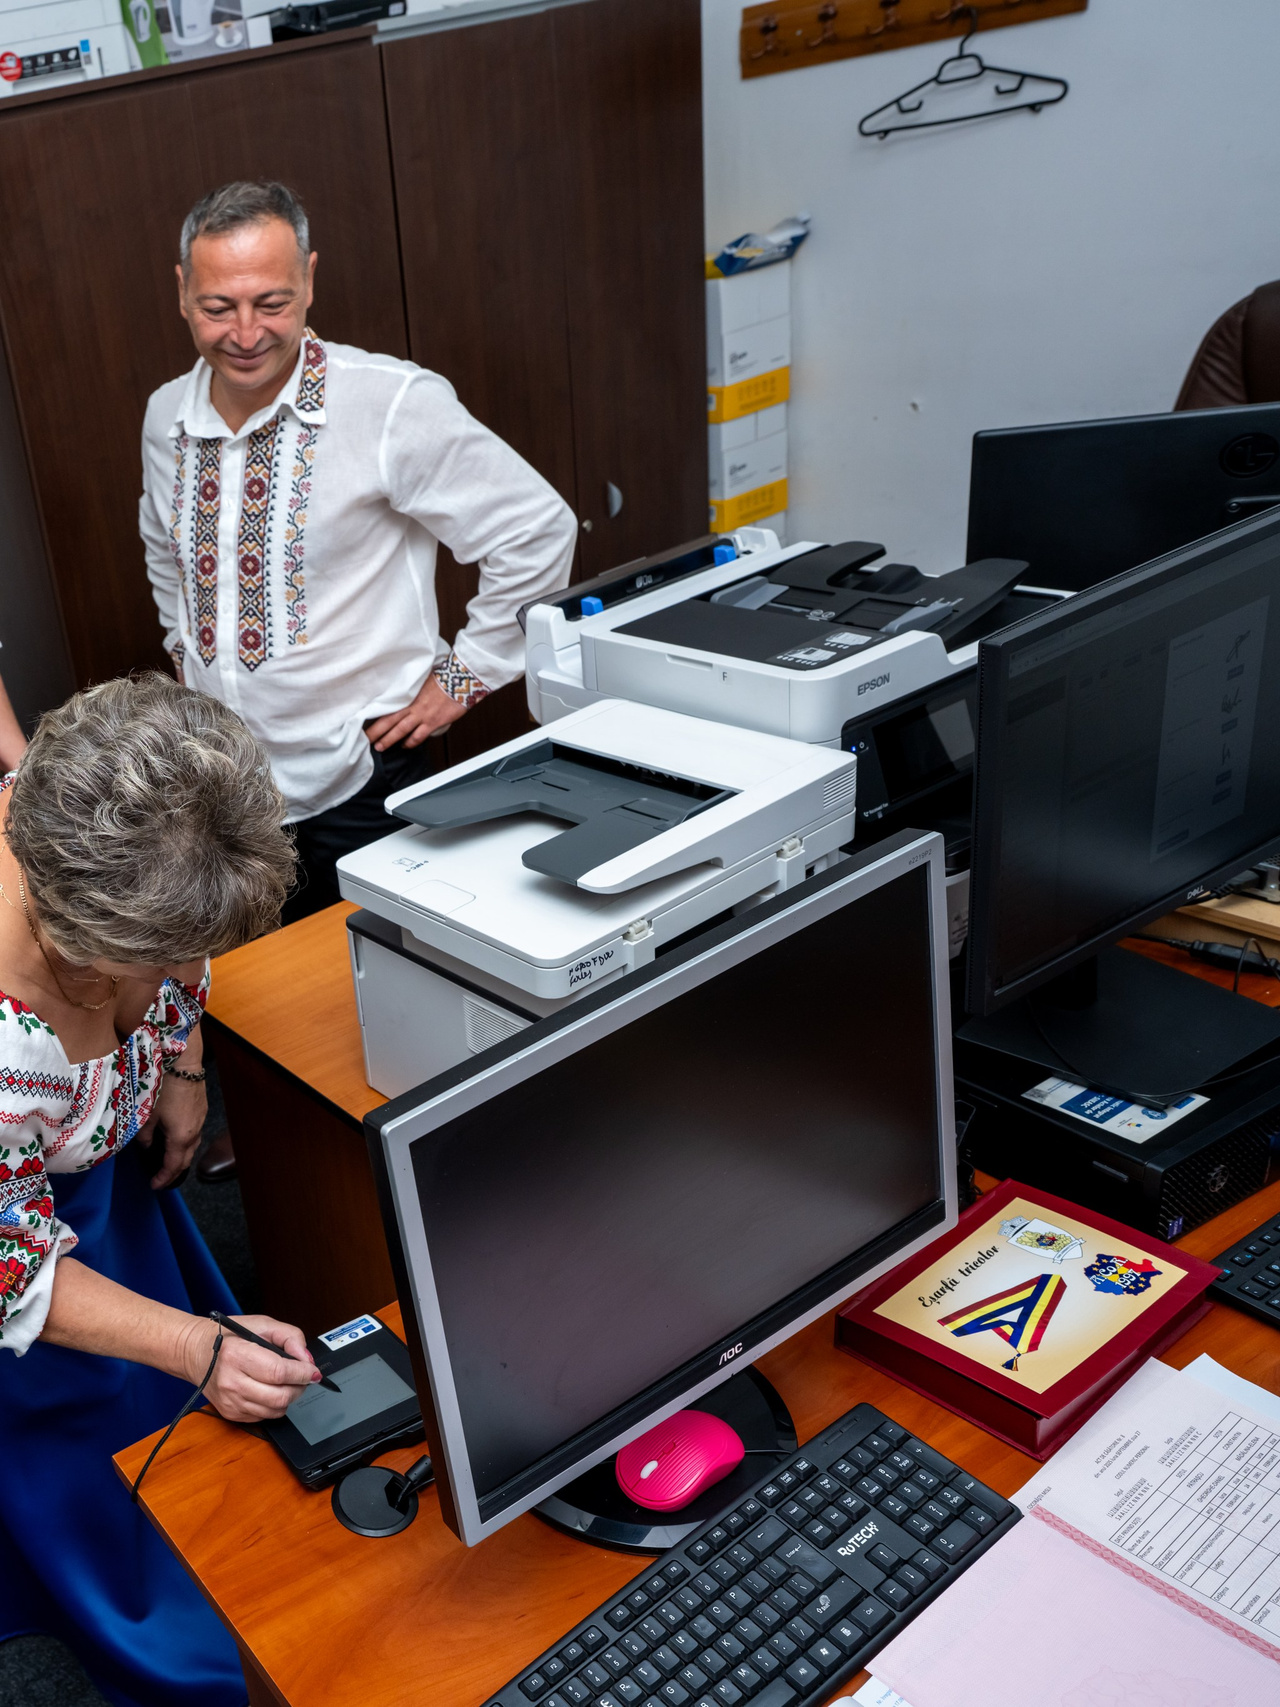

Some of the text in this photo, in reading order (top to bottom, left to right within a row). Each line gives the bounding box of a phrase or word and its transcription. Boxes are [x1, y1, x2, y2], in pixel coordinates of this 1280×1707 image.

[857, 672, 890, 696] EPSON
[1187, 885, 1204, 899] DELL
[958, 1246, 999, 1277] tricolor
[1115, 1268, 1141, 1288] 1997
[719, 1342, 743, 1365] AOC
[1222, 1431, 1242, 1450] CONSTANTIN
[1114, 1444, 1150, 1480] CODUL NUMERIC PERSONAL
[819, 1478, 829, 1487] Page
[964, 1481, 975, 1490] Enter
[868, 1485, 879, 1494] Home
[804, 1492, 815, 1500] Home
[843, 1496, 854, 1505] Page
[746, 1503, 755, 1511] F12
[847, 1499, 857, 1507] Down
[789, 1506, 799, 1514] Insert
[812, 1524, 823, 1534] Delete
[920, 1523, 930, 1532] End
[712, 1530, 721, 1538] F10
[1138, 1529, 1150, 1542] familie
[939, 1537, 947, 1545] 0
[1138, 1545, 1154, 1560] Prenume
[729, 1591, 736, 1599] P
[712, 1605, 721, 1614] O
[865, 1607, 874, 1615] Ctrl
[721, 1638, 731, 1647] K
[657, 1651, 665, 1659] Y
[704, 1654, 711, 1663] J
[549, 1662, 558, 1670] F2
[638, 1667, 648, 1676] T
[684, 1669, 694, 1679] H
[737, 1667, 748, 1677] M
[666, 1685, 675, 1694] G
